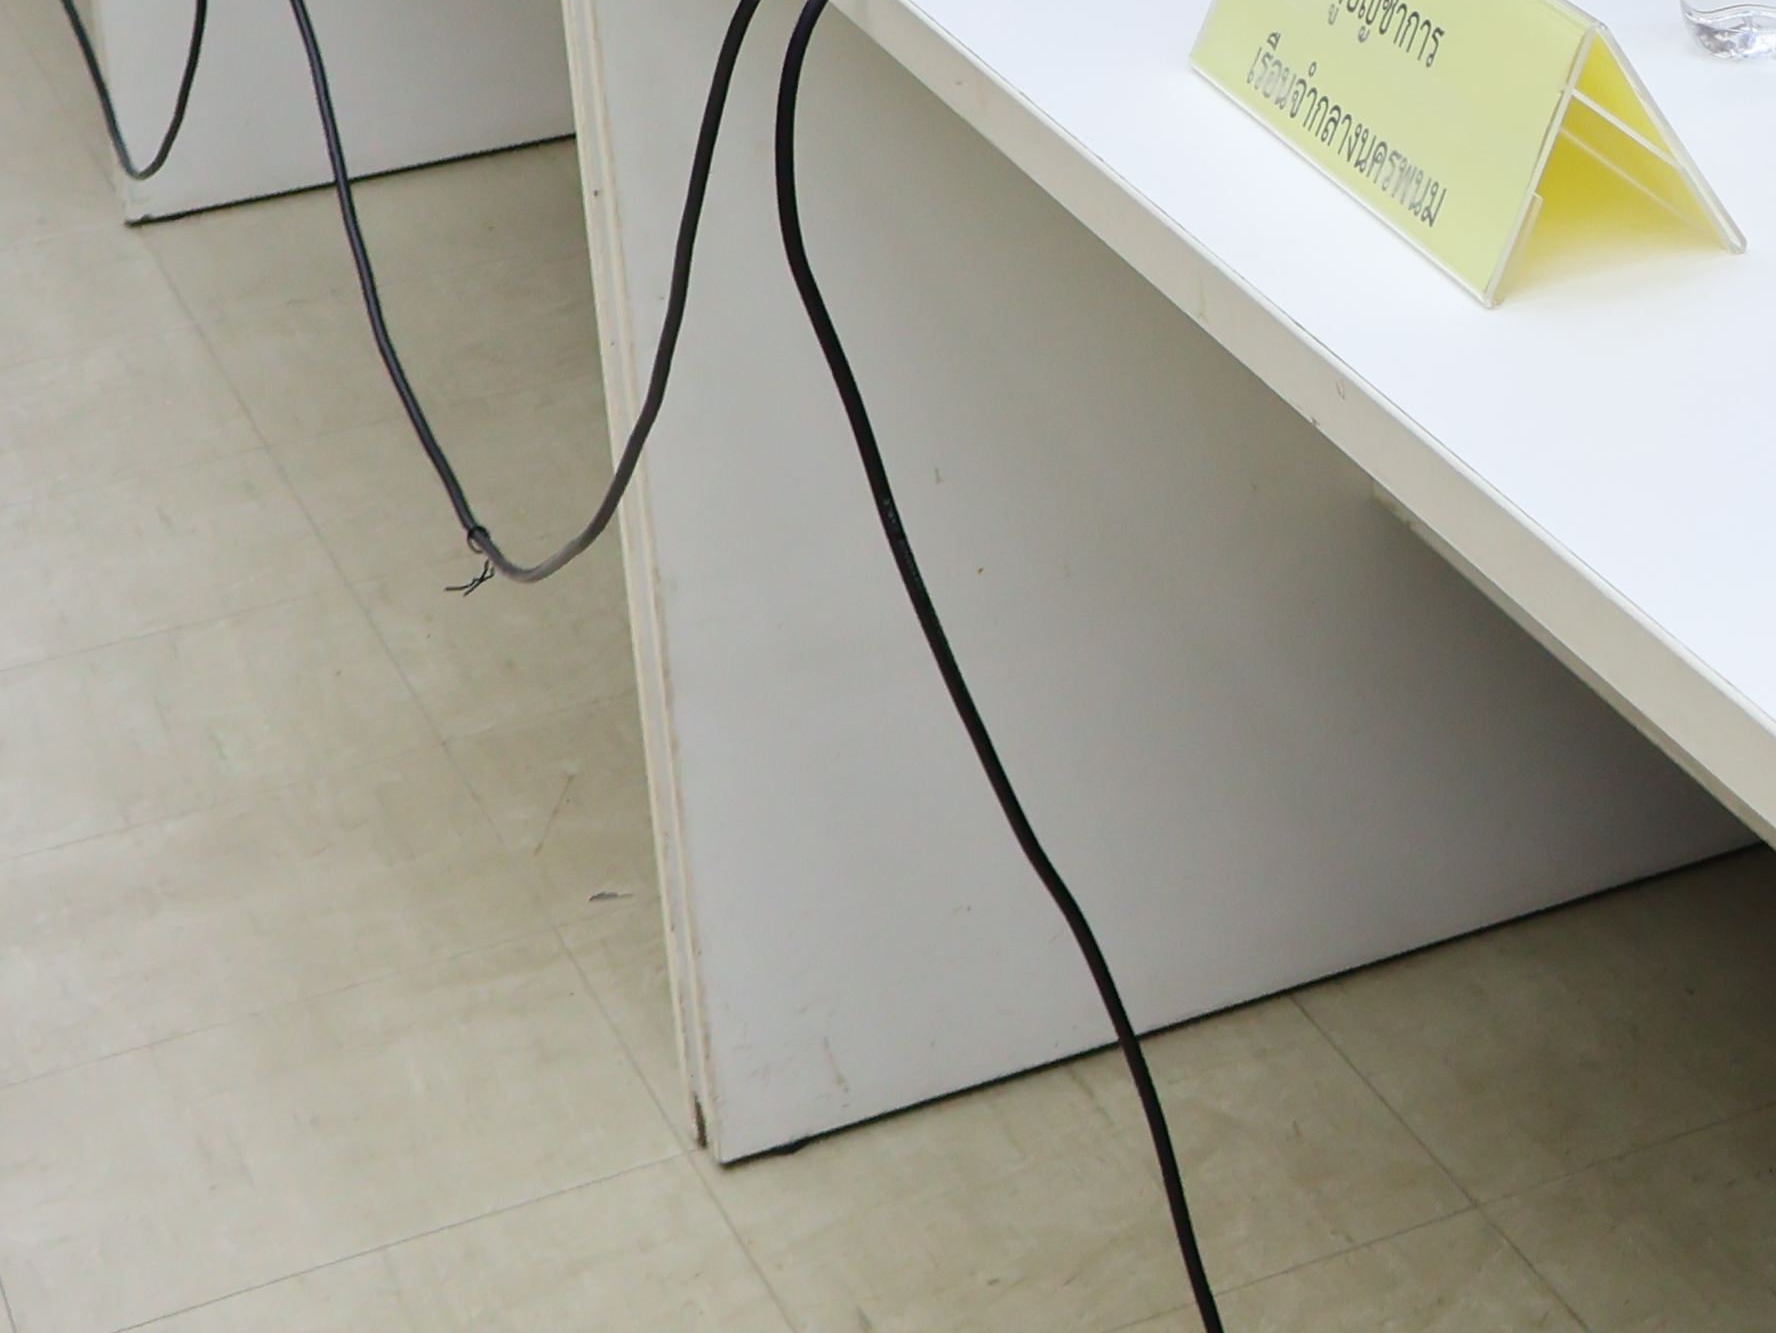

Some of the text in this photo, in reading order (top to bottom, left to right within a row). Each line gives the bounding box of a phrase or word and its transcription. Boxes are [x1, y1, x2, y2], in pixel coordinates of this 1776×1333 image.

[1245, 30, 1448, 228] เรือนจำกลางนครพนม
